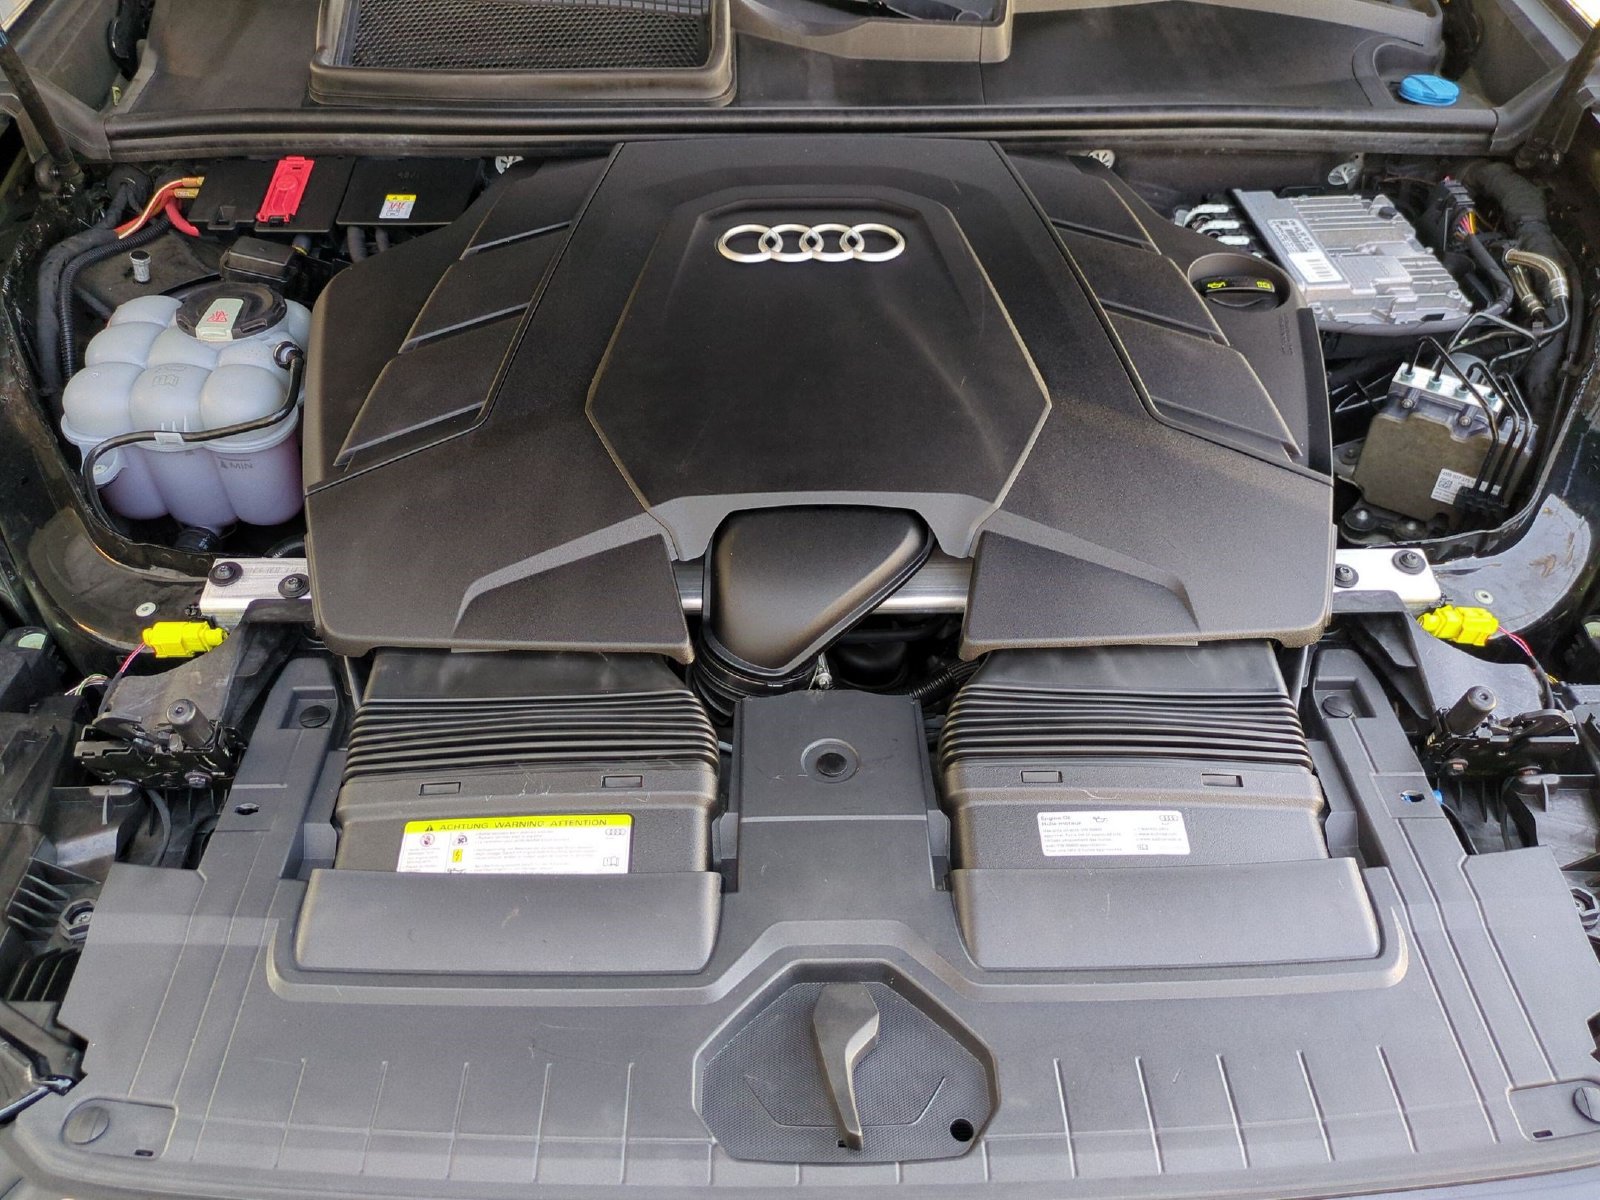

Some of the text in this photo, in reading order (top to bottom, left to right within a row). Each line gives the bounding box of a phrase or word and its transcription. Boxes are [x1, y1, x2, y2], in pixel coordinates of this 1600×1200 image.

[440, 819, 607, 830] ACHTUNG WARNING ATTENTION
